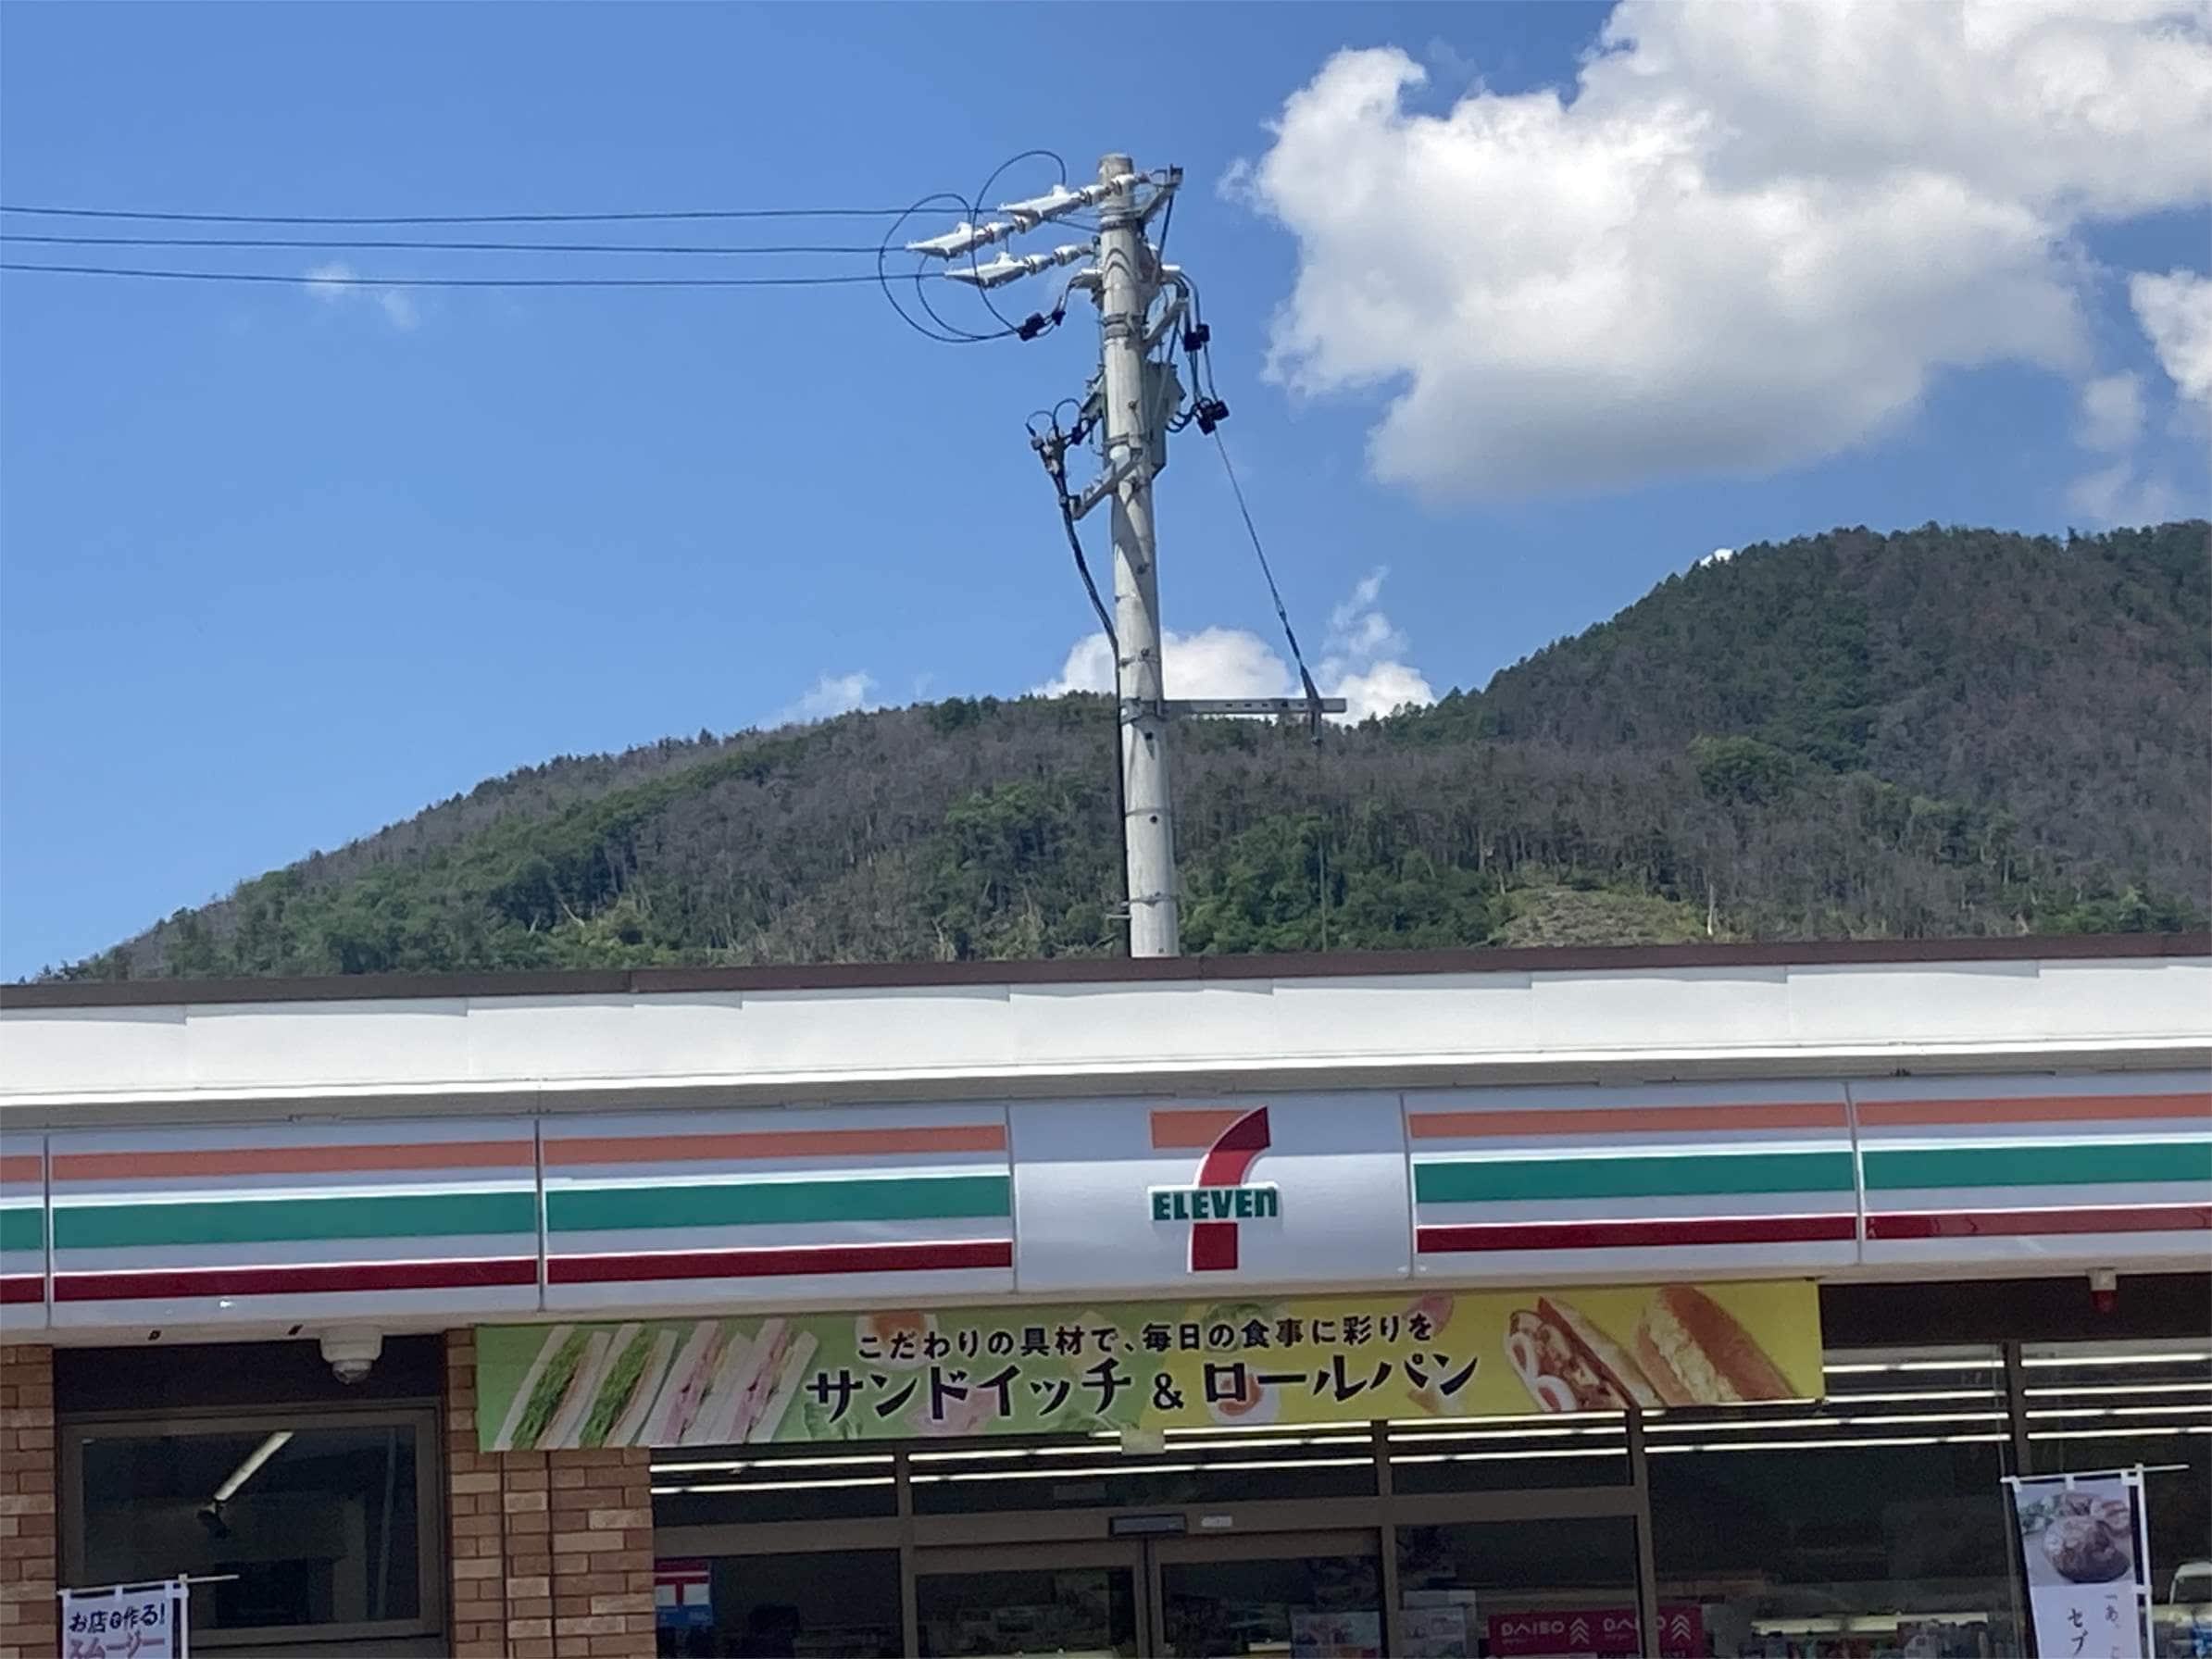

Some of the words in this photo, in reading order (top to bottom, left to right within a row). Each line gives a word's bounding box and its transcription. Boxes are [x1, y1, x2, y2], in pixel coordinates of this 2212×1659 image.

[1150, 1105, 1271, 1271] 7
[858, 1313, 1432, 1359] こだわりの具材で、毎日の食事に彩りを
[806, 1357, 1131, 1423] サンドイッチ
[1153, 1372, 1184, 1410] &
[1204, 1353, 1478, 1402] ロールパン
[69, 1628, 166, 1659] スムージー
